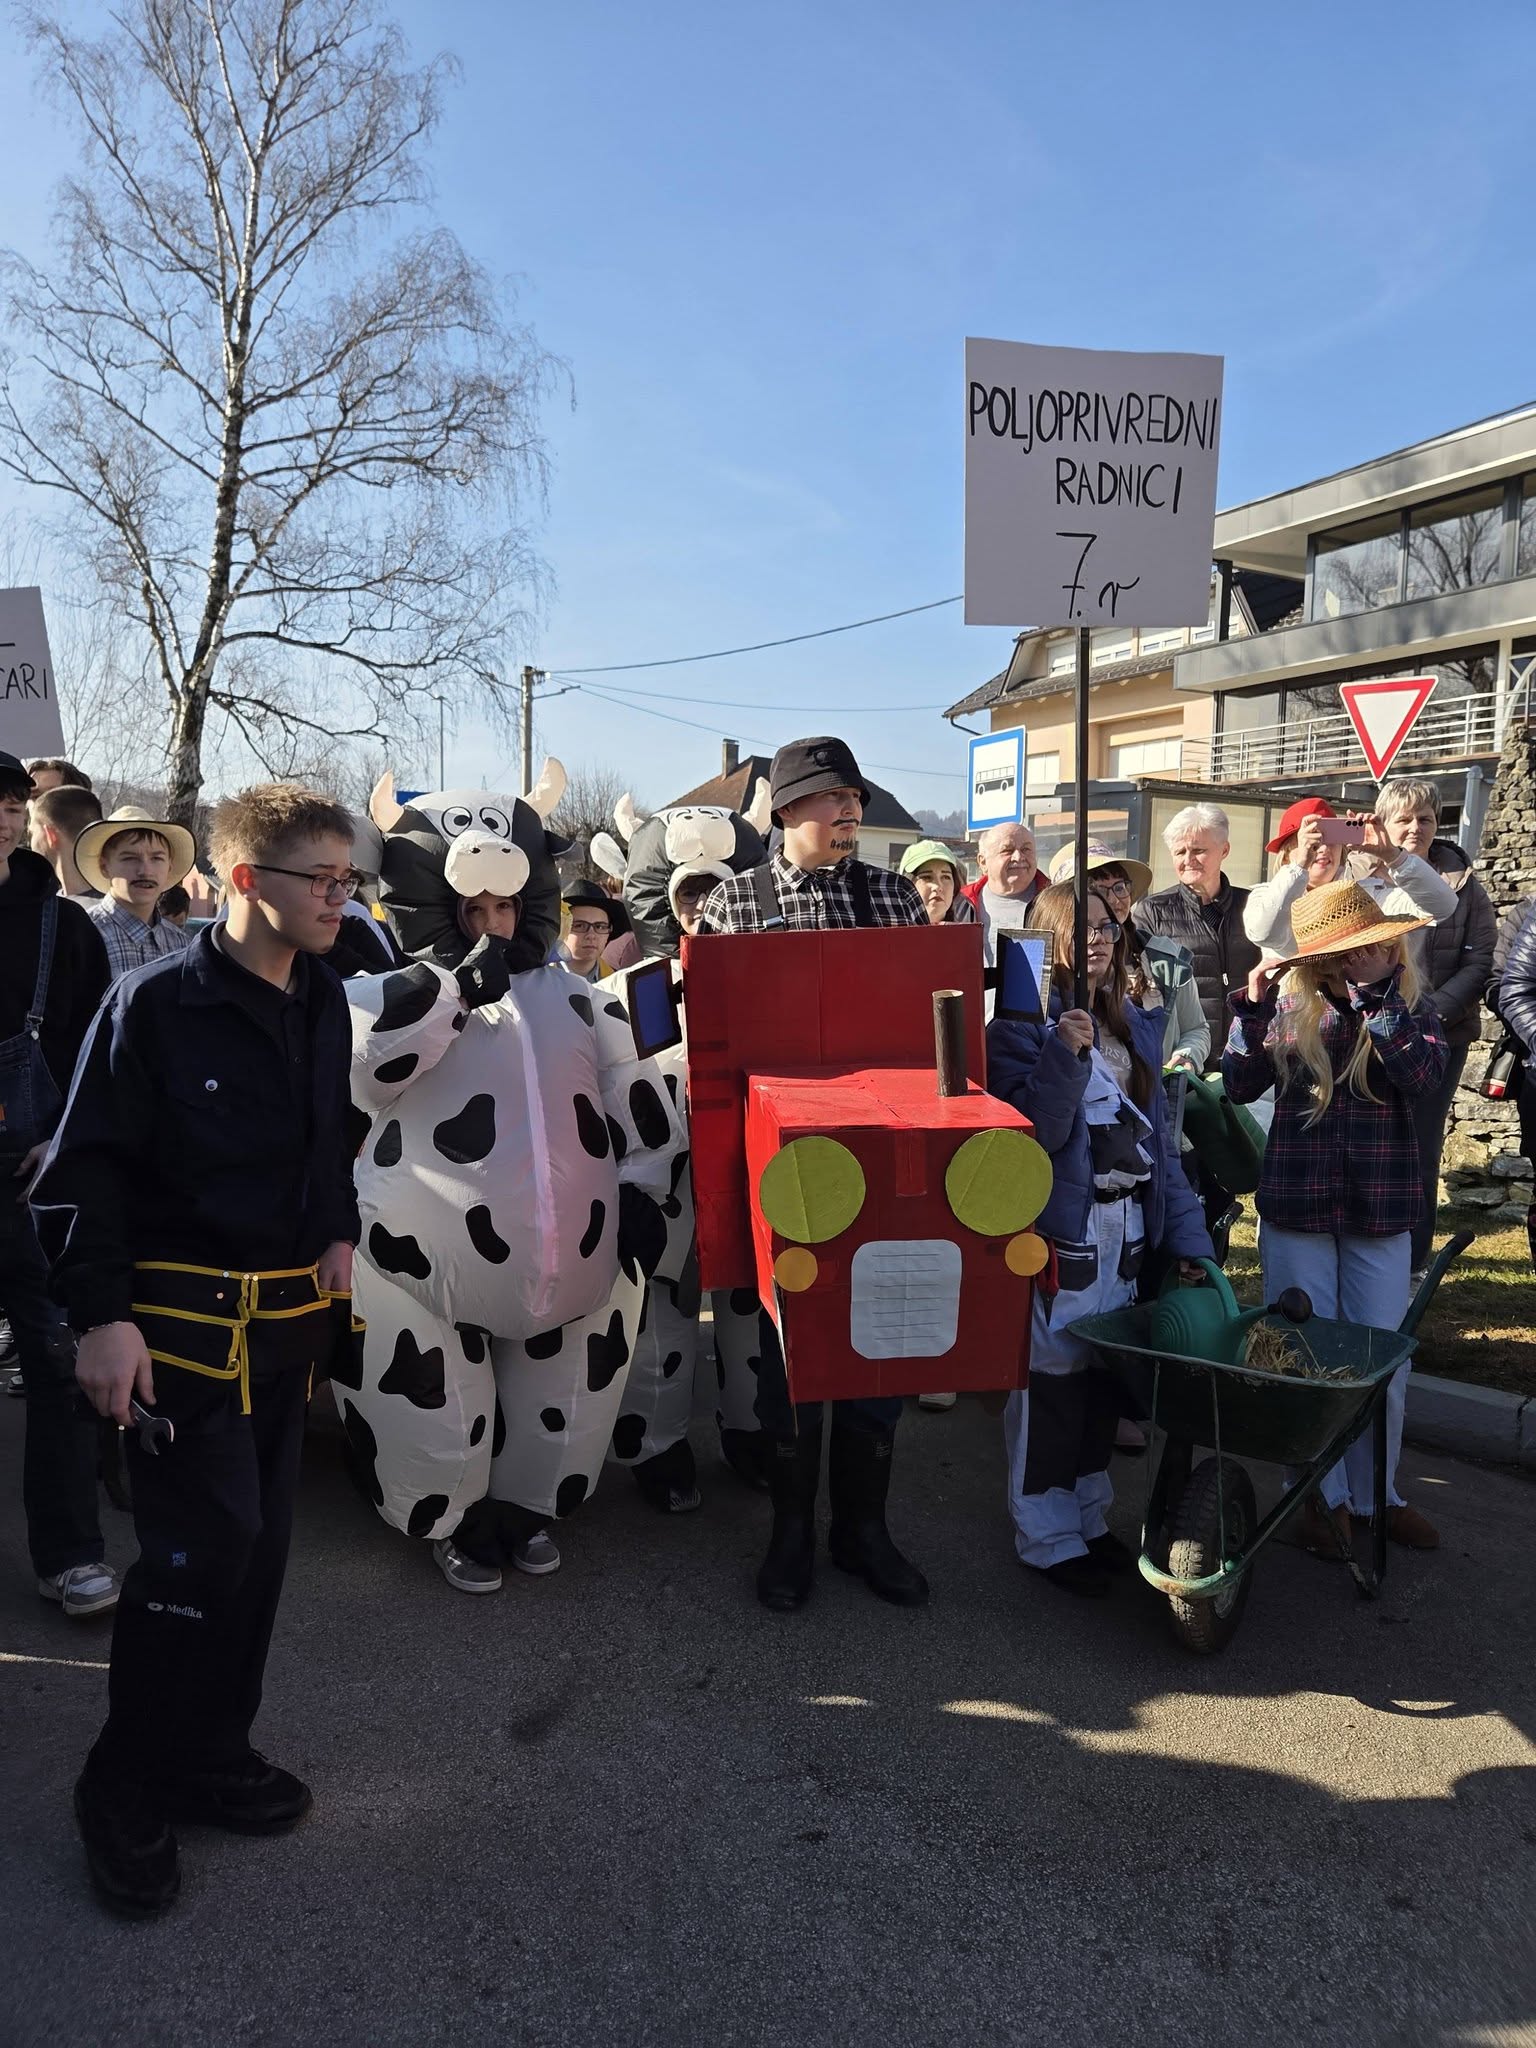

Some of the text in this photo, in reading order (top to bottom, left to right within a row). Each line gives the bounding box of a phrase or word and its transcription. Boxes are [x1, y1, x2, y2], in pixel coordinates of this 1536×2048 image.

[970, 381, 1218, 454] POLJOPRIVREDNI
[1056, 457, 1183, 514] RADNICI
[1056, 532, 1098, 619] 7.
[0, 662, 48, 700] ARI
[166, 1603, 203, 1619] Medika
